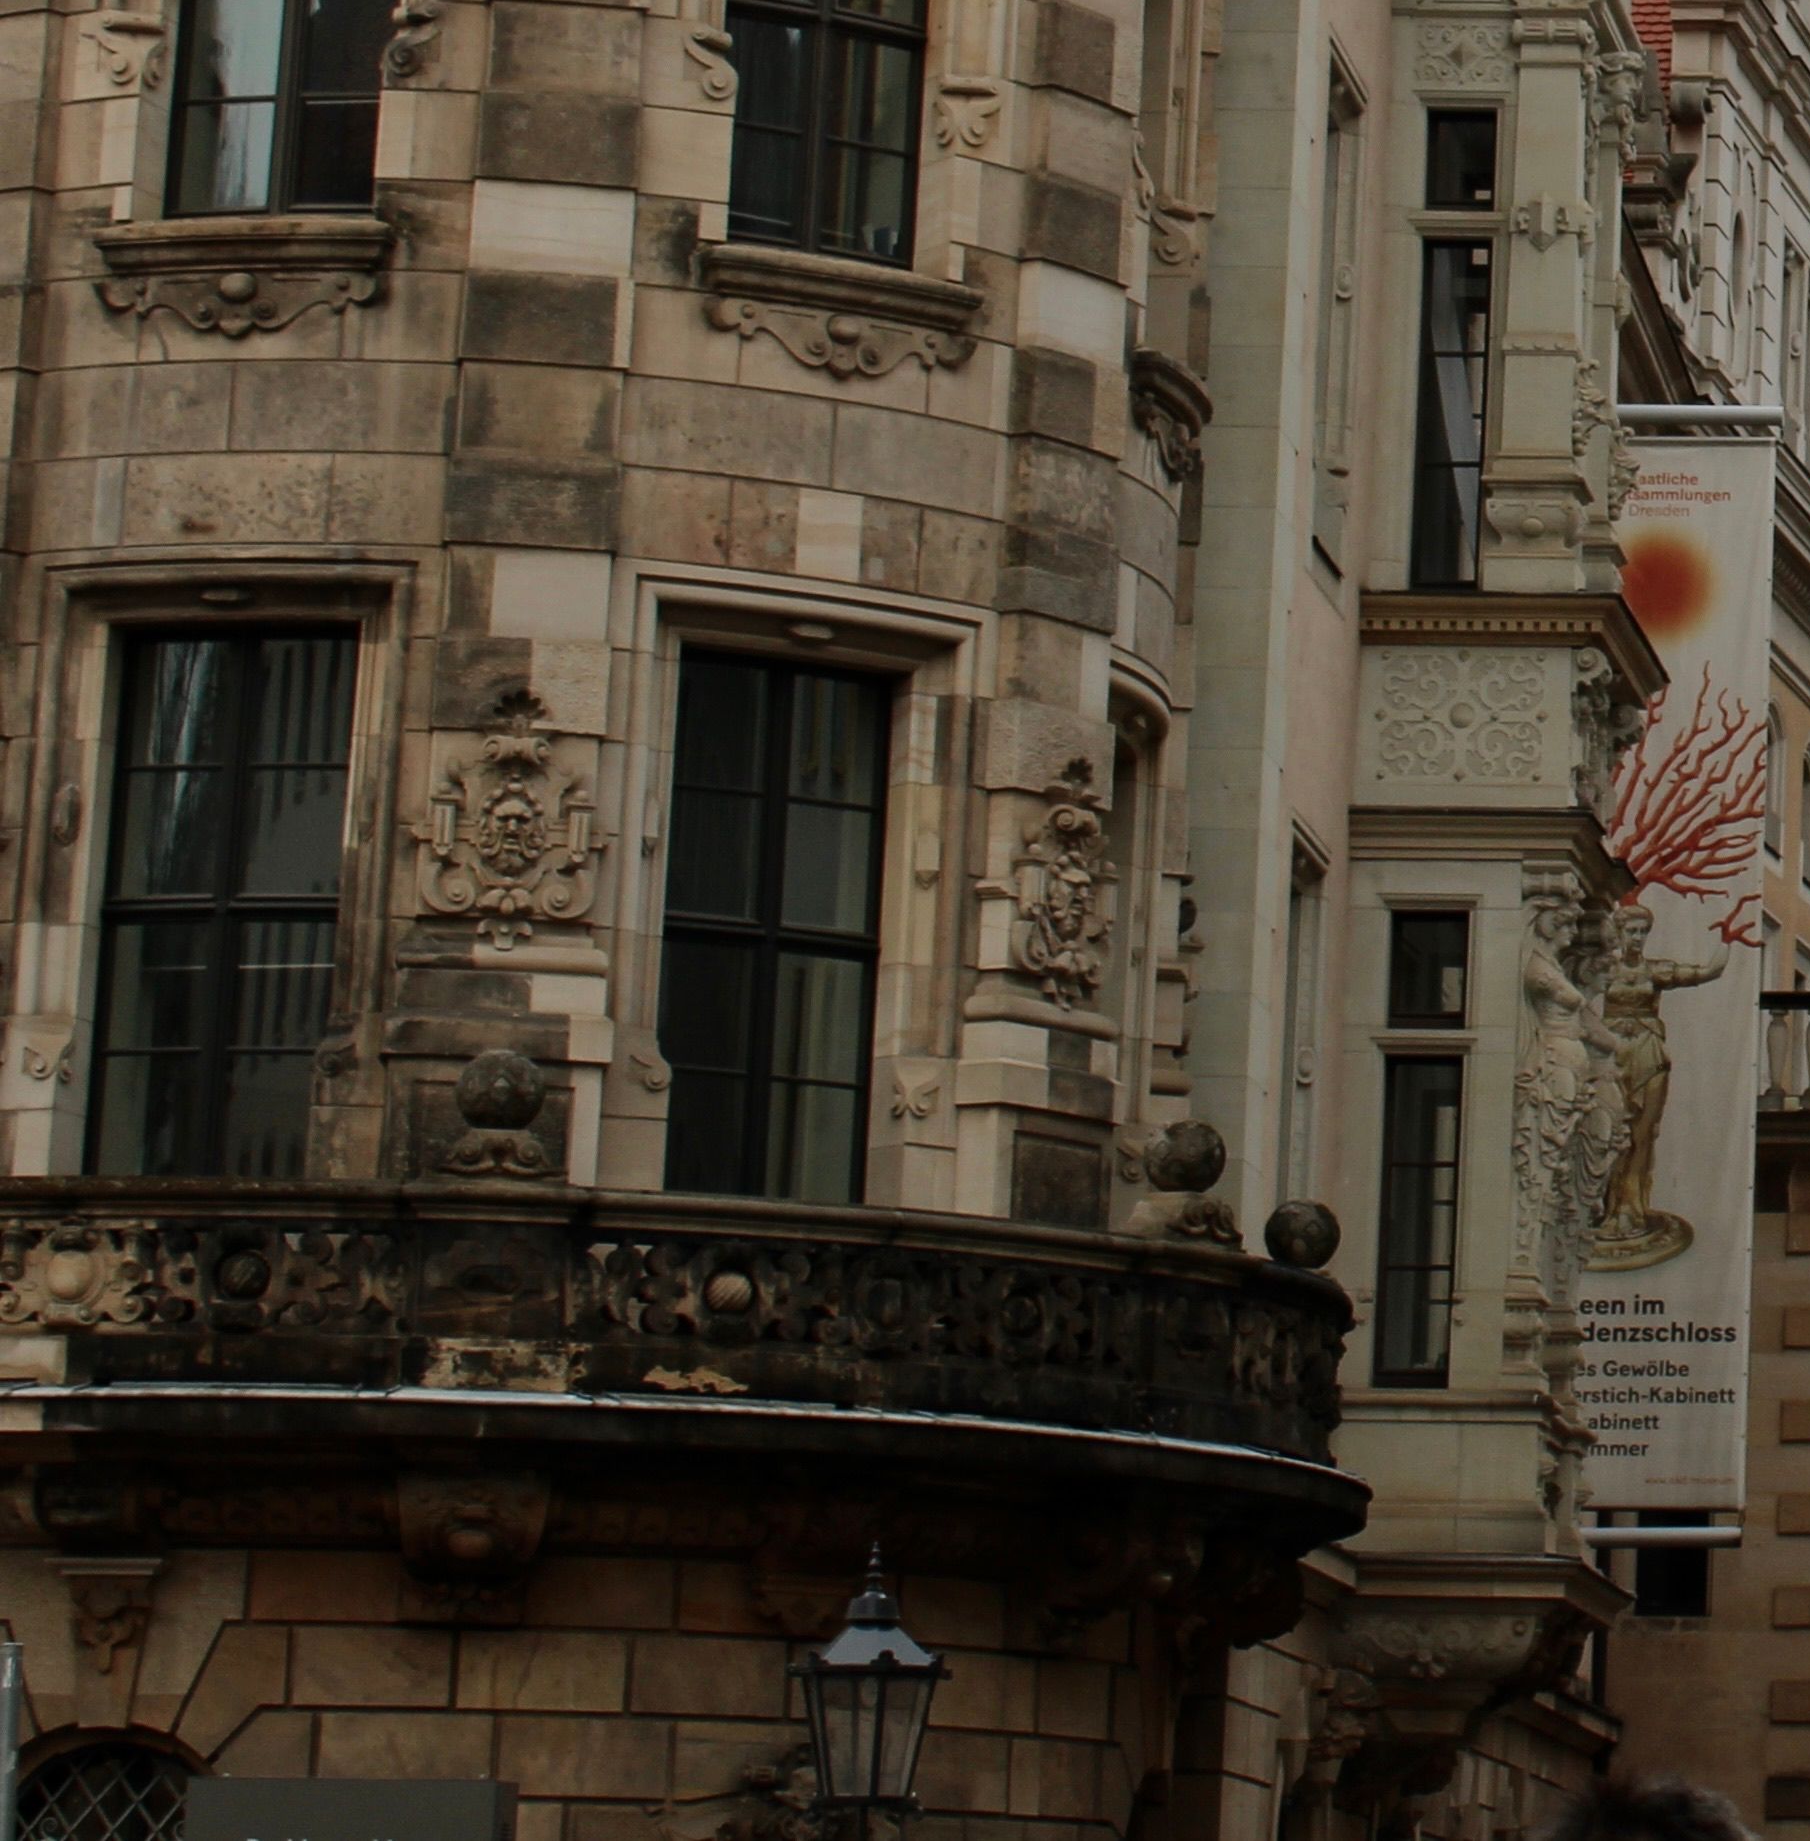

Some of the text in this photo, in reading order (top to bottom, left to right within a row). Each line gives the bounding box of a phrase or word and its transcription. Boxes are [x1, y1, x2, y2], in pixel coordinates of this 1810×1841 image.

[1638, 472, 1699, 486] aatliche
[1628, 504, 1690, 517] Dresden
[1579, 1294, 1664, 1315] een im
[1582, 1321, 1736, 1342] denzschloss
[1602, 1359, 1690, 1377] Gewölbe
[1574, 1386, 1736, 1404] erstich-Kabinett
[1587, 1413, 1660, 1430] abinett
[1590, 1443, 1649, 1457] mmer
